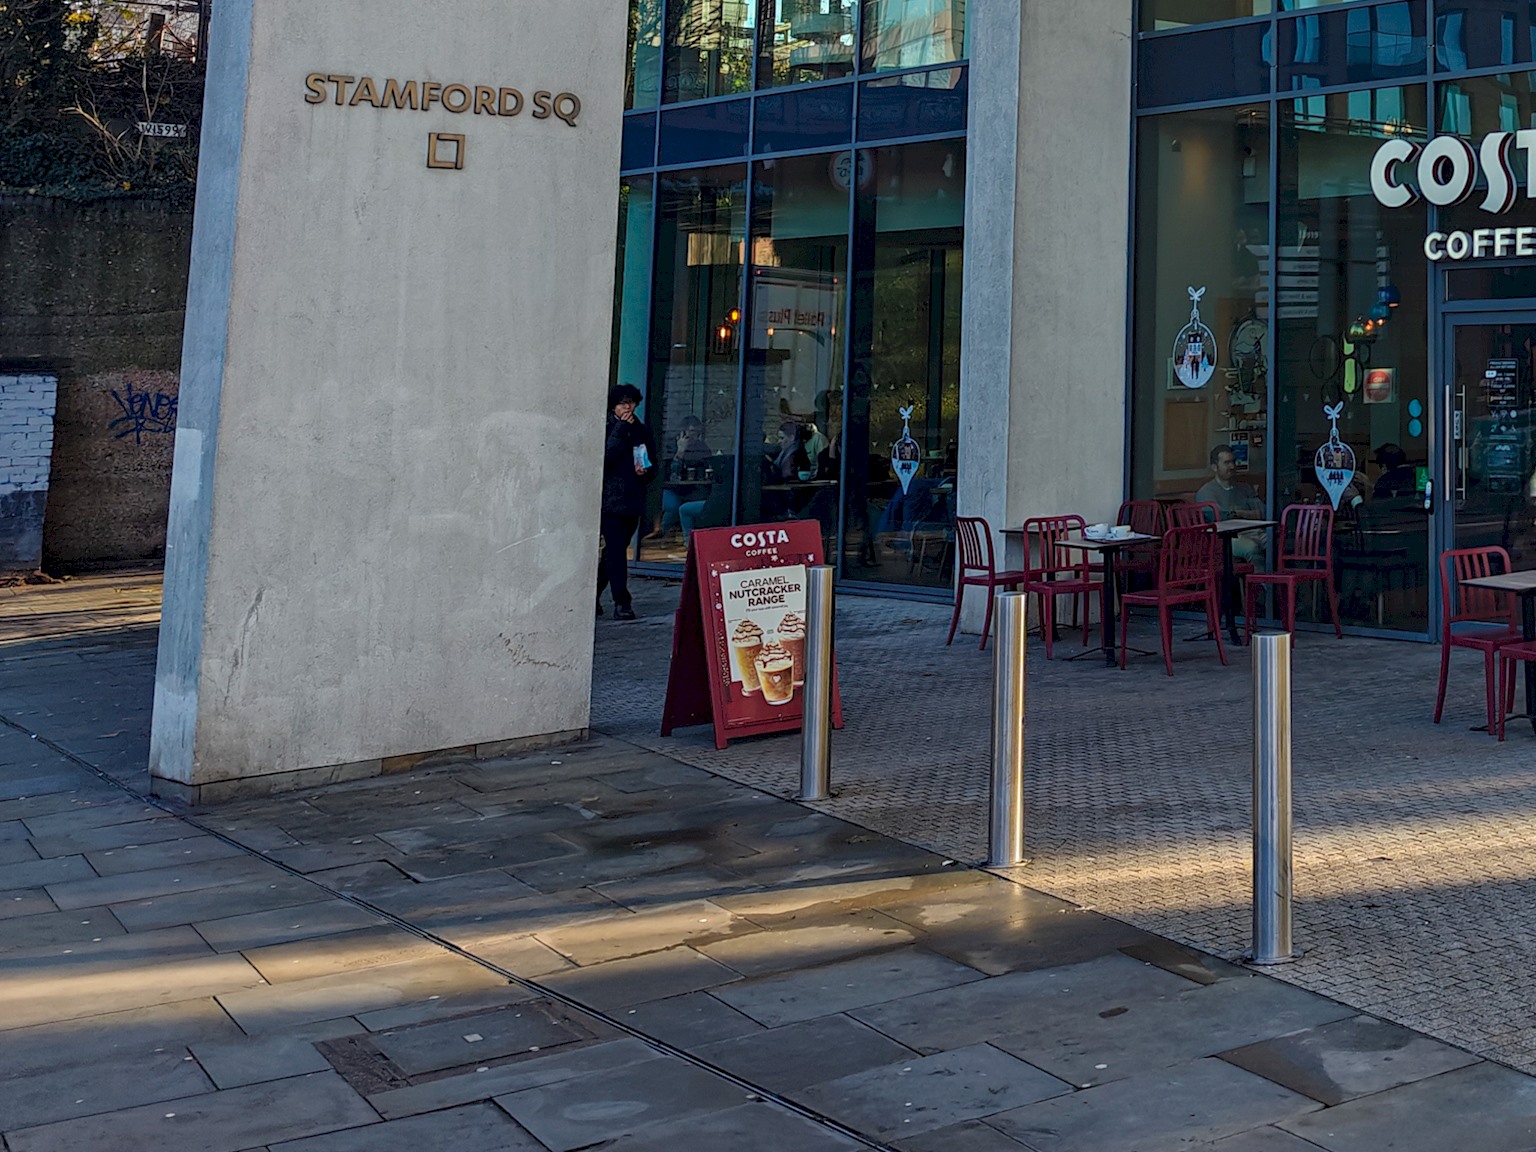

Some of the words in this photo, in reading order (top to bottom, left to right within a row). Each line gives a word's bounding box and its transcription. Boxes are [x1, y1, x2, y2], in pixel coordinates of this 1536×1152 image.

[304, 72, 525, 117] STAMFORD
[532, 90, 582, 127] SQ
[731, 530, 789, 547] COSTA
[745, 548, 778, 556] COFFEE
[740, 575, 790, 589] CARAMEL
[728, 583, 801, 600] NUTCRACKER
[748, 595, 785, 606] RANGE
